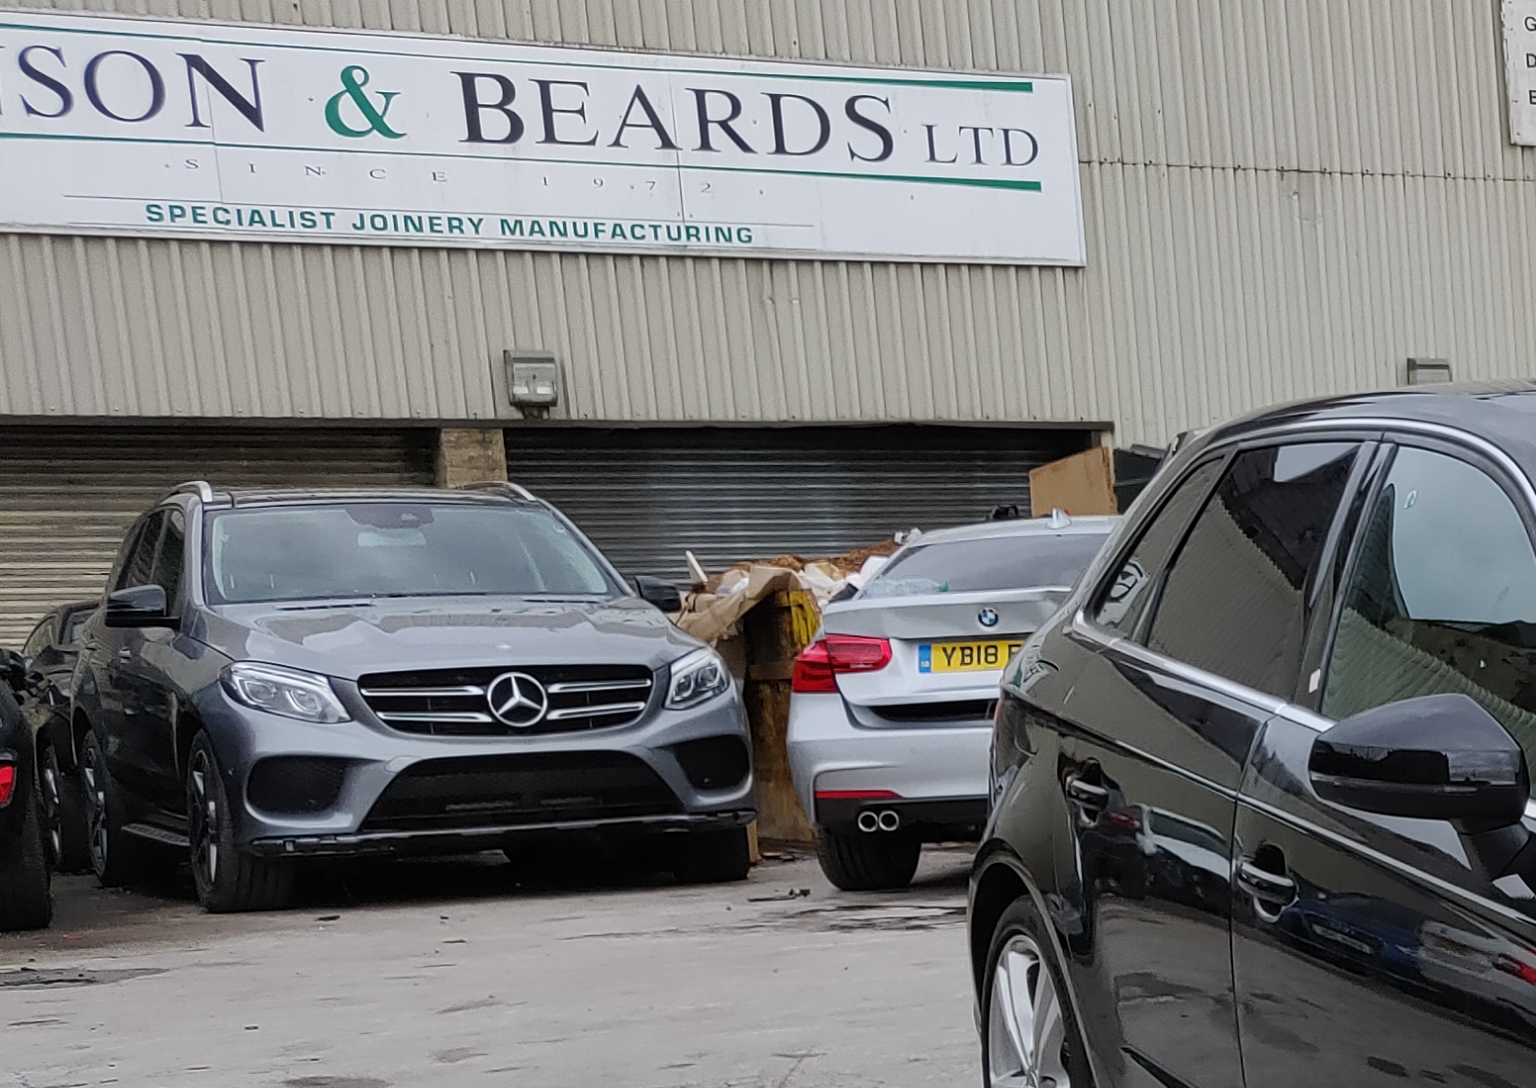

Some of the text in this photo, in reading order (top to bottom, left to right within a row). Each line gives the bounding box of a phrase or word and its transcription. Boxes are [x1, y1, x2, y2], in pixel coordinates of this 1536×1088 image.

[0, 44, 1040, 167] SON & BEARDS LTD
[145, 203, 754, 244] SPECIALIST JOINERY MANUFACTURING
[941, 643, 999, 667] YB18
